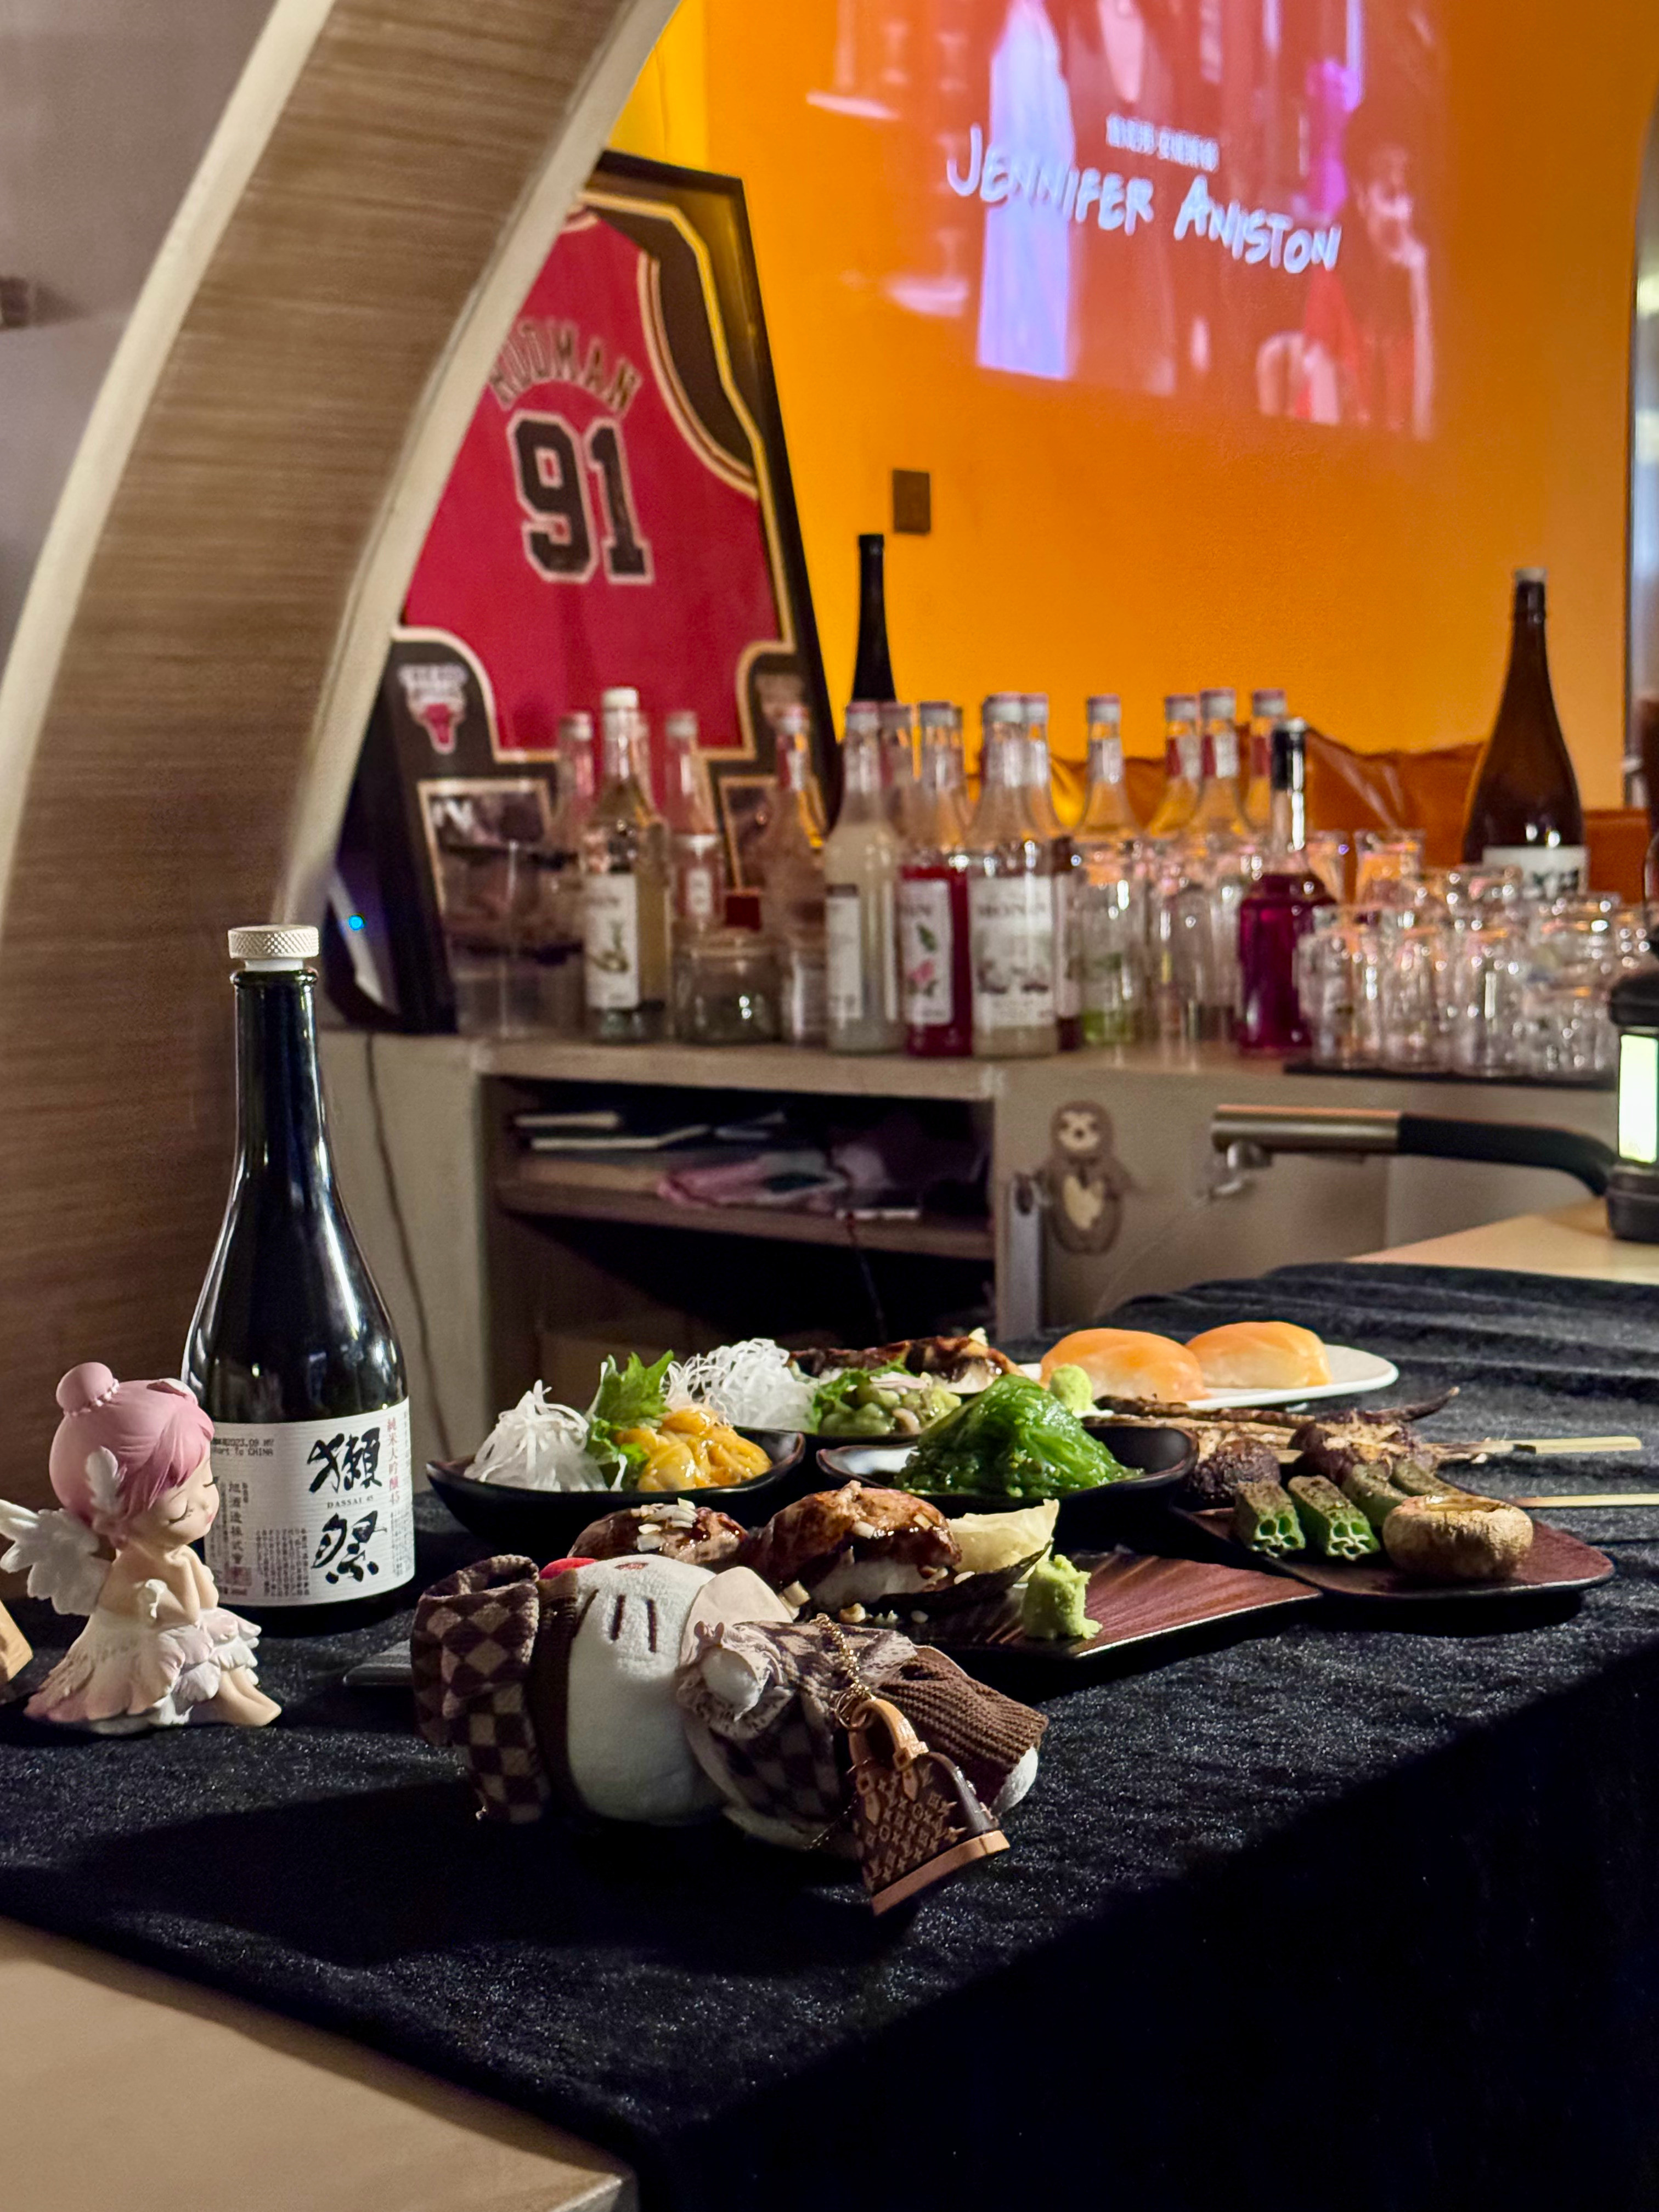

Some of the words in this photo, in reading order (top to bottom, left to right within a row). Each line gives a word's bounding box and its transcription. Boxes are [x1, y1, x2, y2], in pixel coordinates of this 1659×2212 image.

[946, 123, 1154, 236] JENNIFER
[1173, 174, 1342, 274] ANISTON
[506, 408, 655, 585] 91
[327, 1497, 362, 1509] DASSAI
